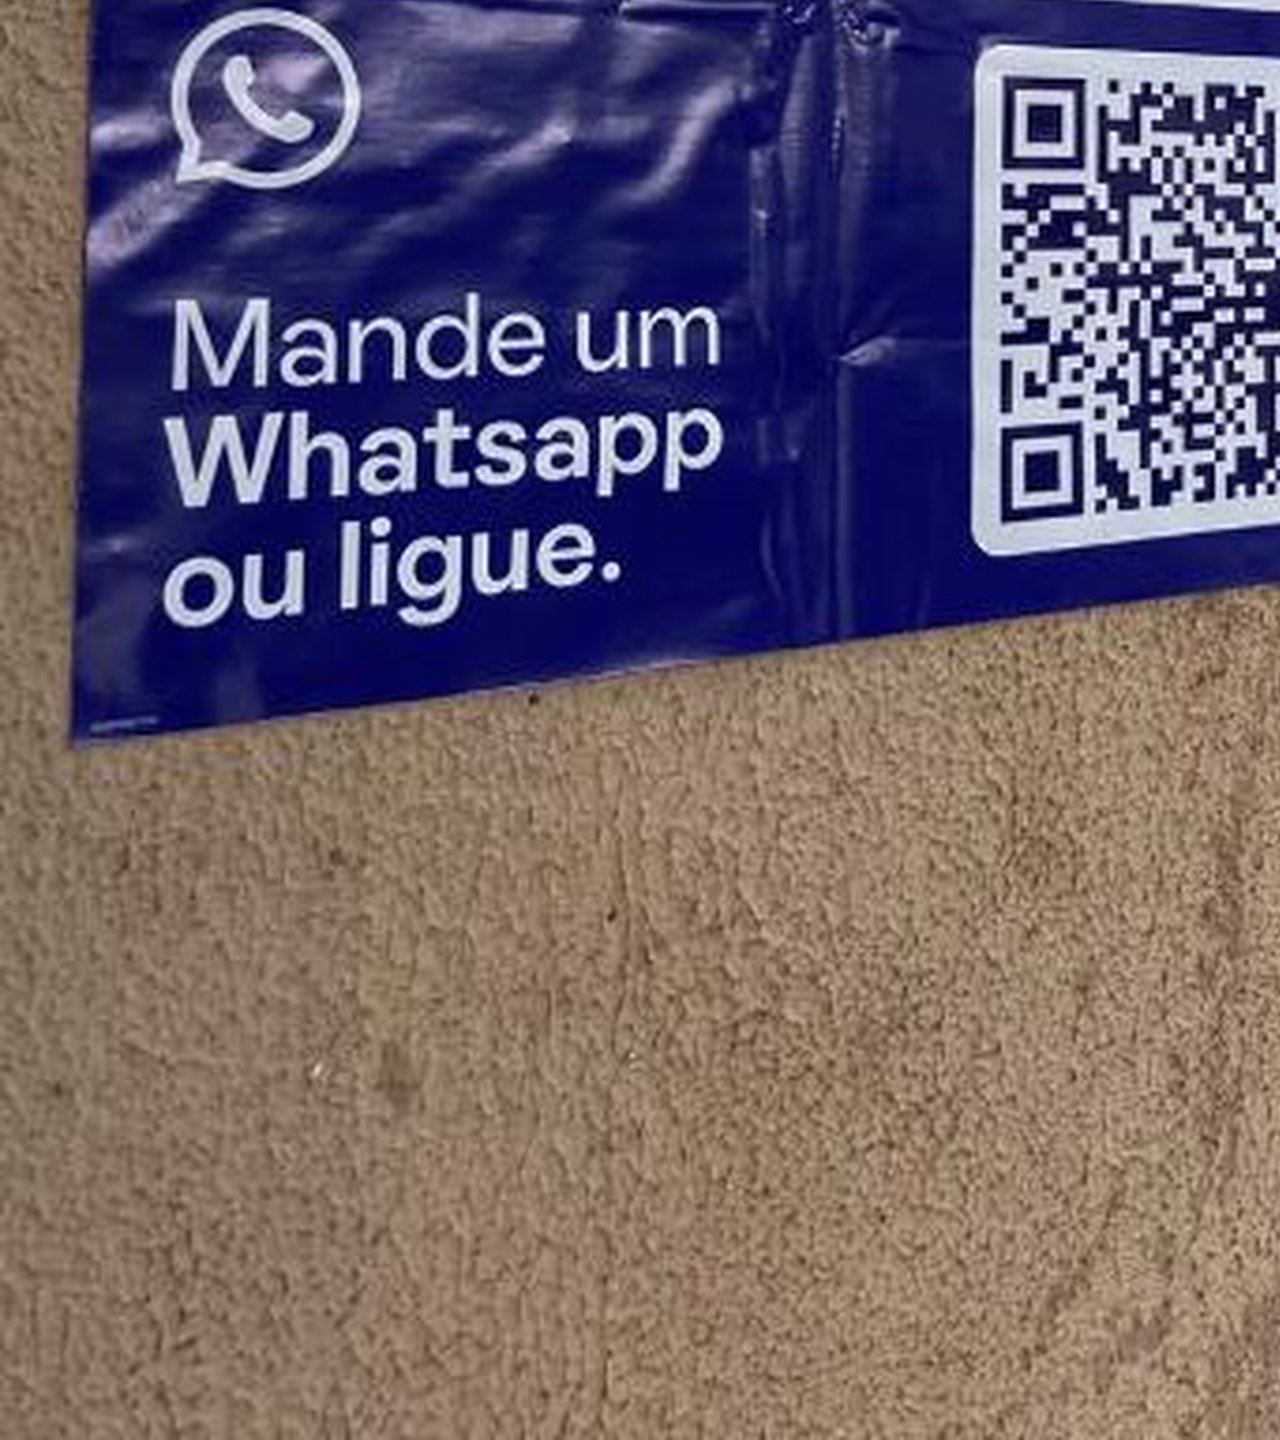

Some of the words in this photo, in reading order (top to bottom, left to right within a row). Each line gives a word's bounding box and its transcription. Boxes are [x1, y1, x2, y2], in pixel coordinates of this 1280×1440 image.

[170, 291, 546, 391] Mande
[575, 305, 721, 373] um
[162, 407, 723, 509] Whatsapp
[162, 549, 305, 629] ou
[339, 515, 621, 627] ligue.
